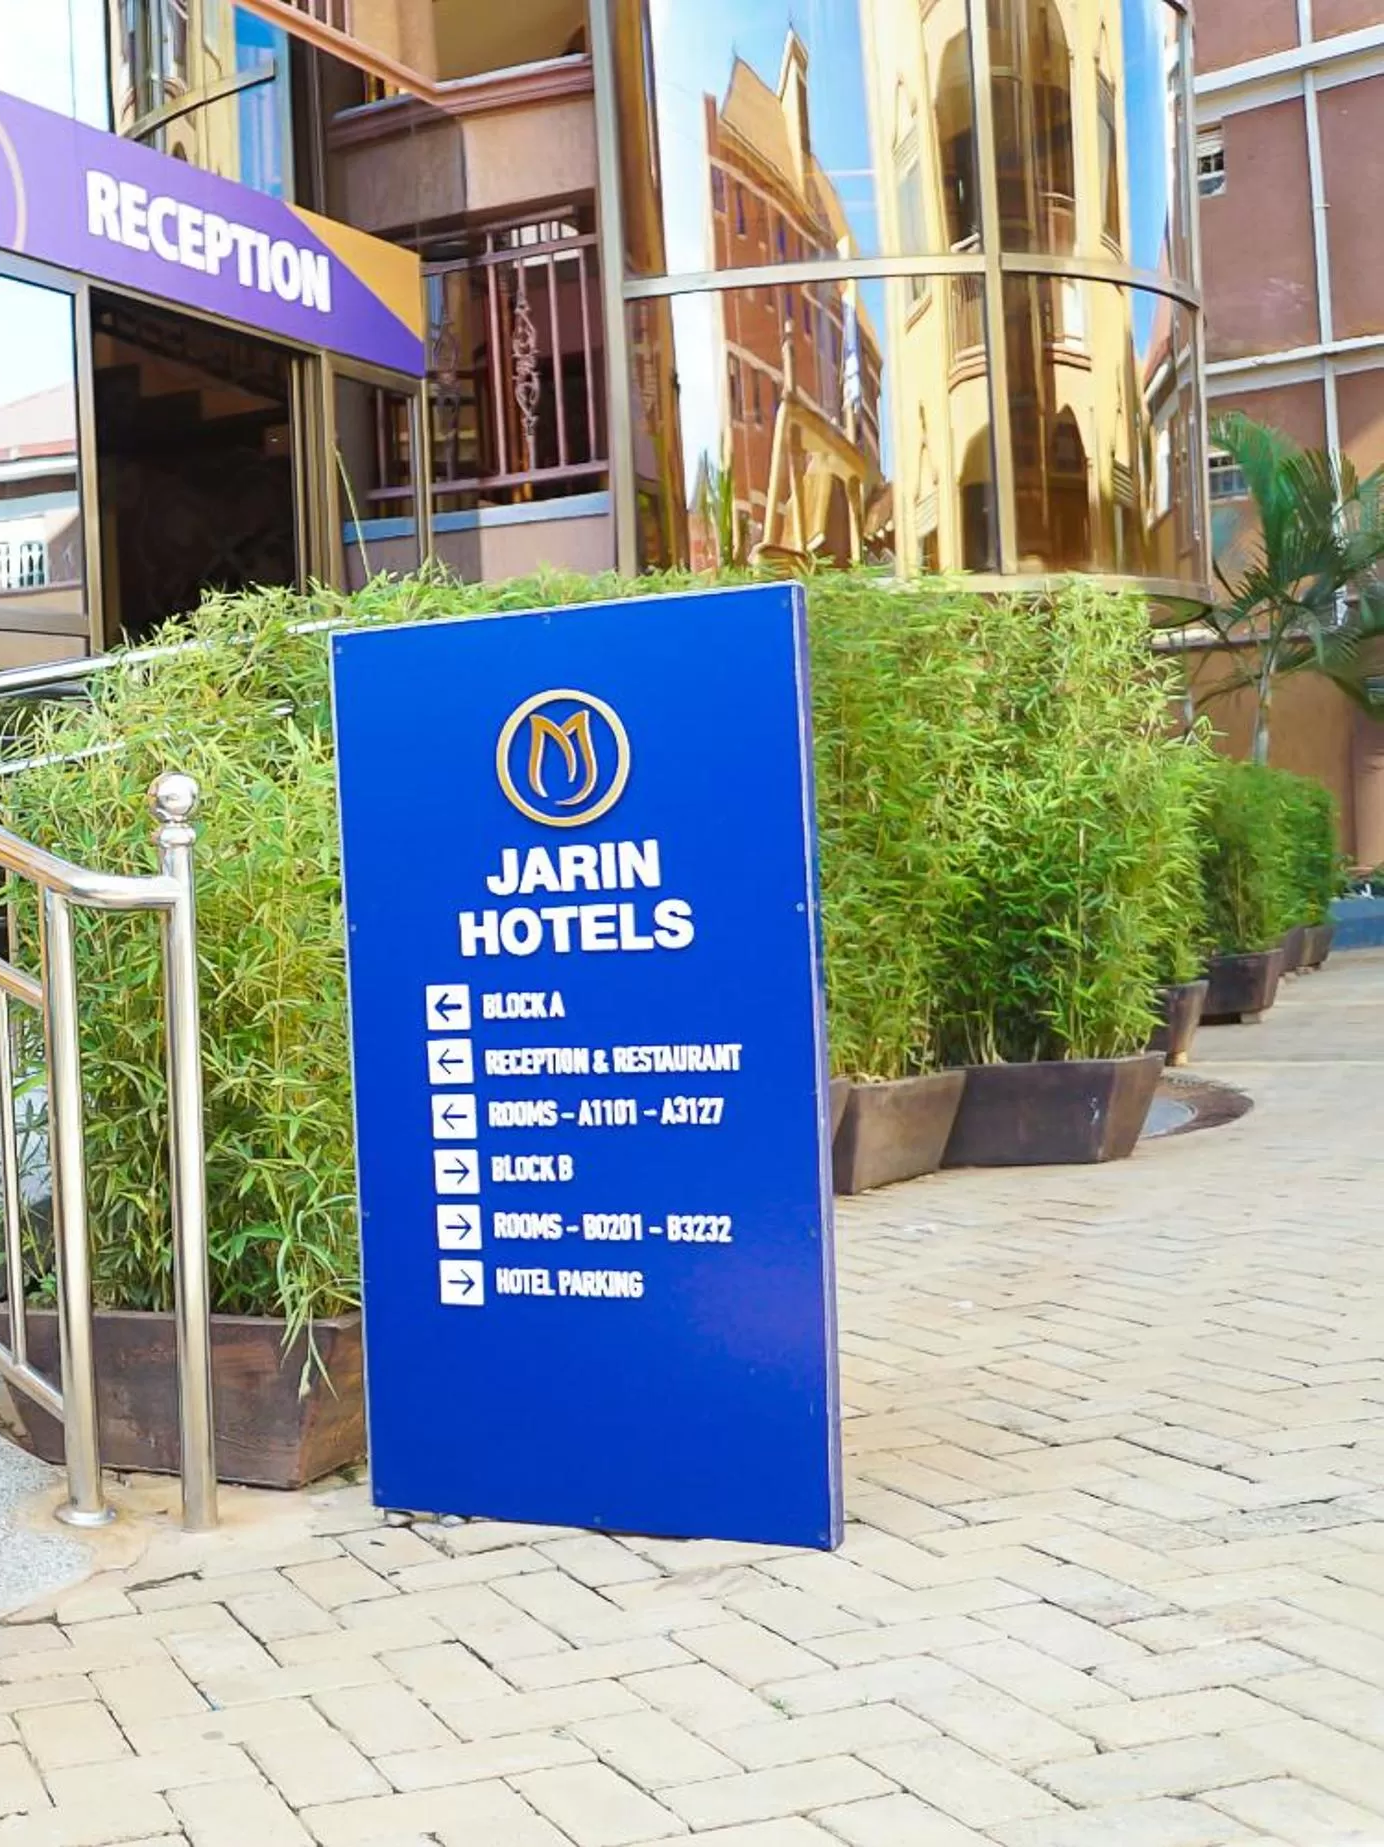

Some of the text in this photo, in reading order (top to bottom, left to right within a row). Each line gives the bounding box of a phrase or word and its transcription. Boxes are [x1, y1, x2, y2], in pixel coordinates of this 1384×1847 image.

[86, 169, 332, 312] RECEPTION
[487, 839, 661, 896] JARIN
[459, 899, 694, 956] HOTELS
[482, 991, 565, 1019] BLOCK A
[484, 1043, 743, 1076] RECEPTION & RESTAURANT
[488, 1100, 558, 1127] ROOMS
[577, 1098, 638, 1127] A1101
[660, 1096, 724, 1125] A3127
[491, 1154, 574, 1182] BLOCK B
[493, 1211, 563, 1240] ROOMS
[582, 1213, 643, 1241] B0201
[495, 1267, 644, 1298] HOTEL PARKING
